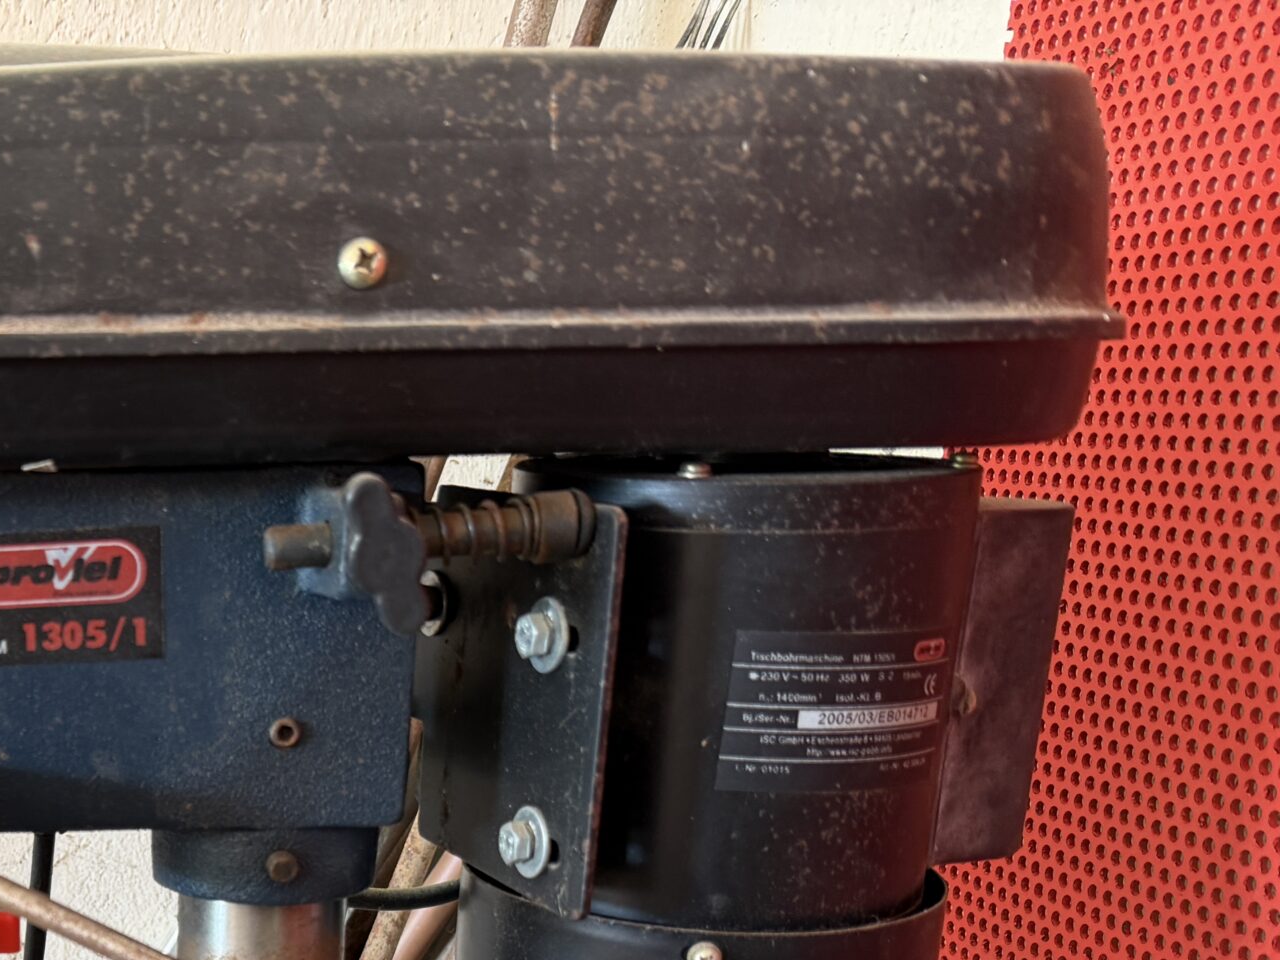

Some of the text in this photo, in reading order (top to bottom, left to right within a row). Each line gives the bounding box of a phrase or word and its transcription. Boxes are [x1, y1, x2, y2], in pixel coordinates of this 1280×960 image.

[22, 616, 148, 652] 1305/1
[750, 649, 844, 663] Tischbohrmaschine
[760, 671, 781, 683] 230
[781, 671, 791, 683] V
[800, 672, 814, 684] 50
[815, 672, 830, 684] Hz
[837, 672, 858, 685] 350
[860, 671, 871, 683] W
[759, 734, 777, 745] ISC
[778, 735, 805, 746] GmbH
